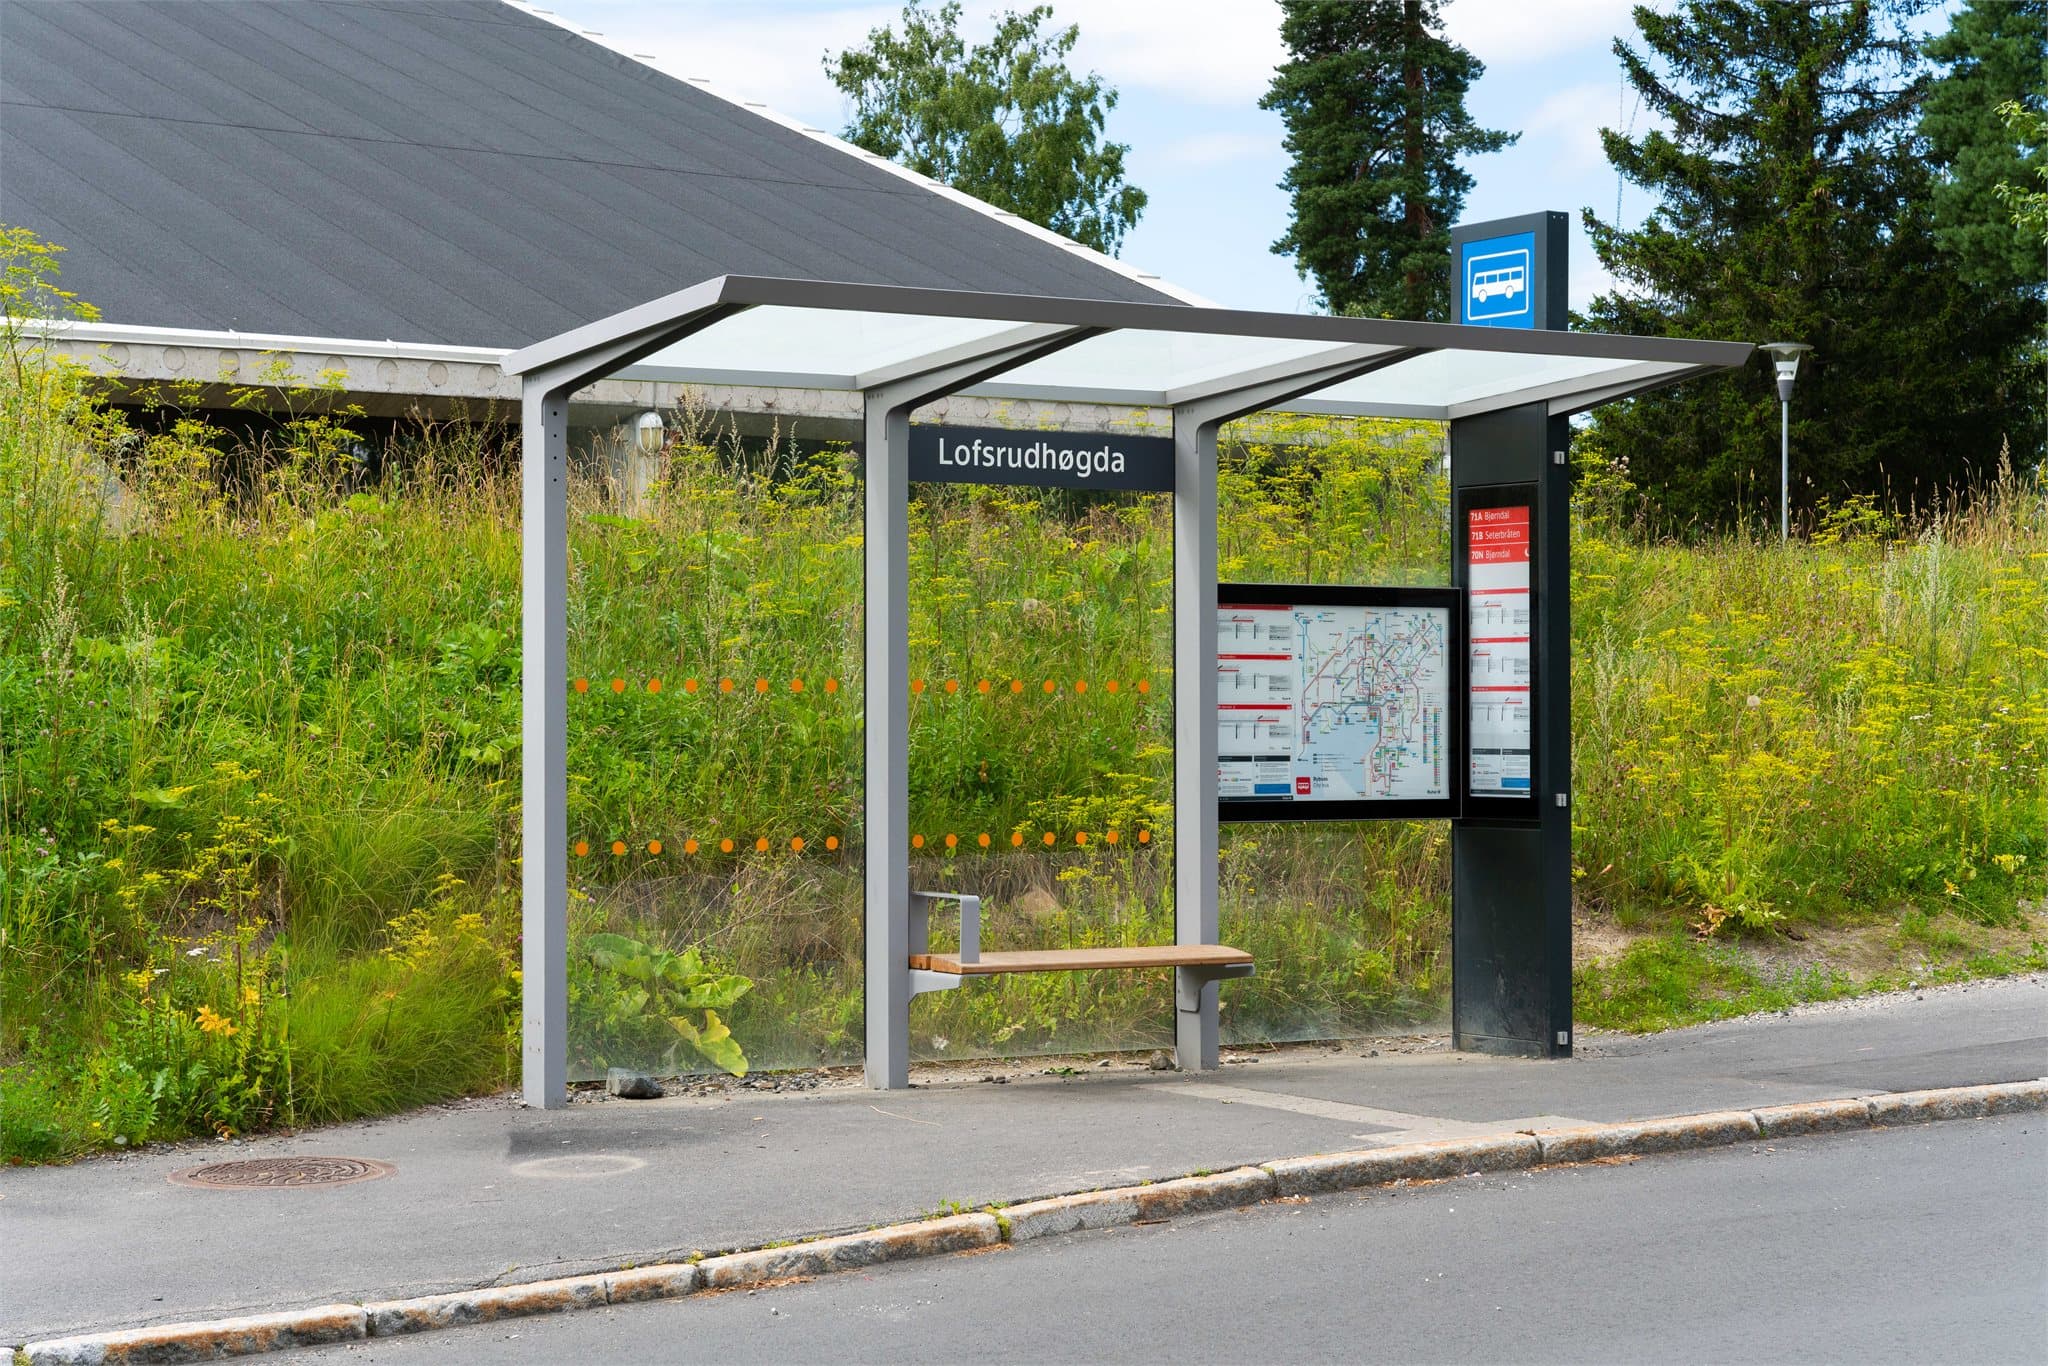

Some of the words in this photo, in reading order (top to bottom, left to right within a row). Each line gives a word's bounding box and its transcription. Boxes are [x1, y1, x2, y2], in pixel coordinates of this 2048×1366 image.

[938, 437, 1126, 479] Lofsrudhøgda
[1470, 512, 1483, 521] 71A
[1471, 531, 1484, 540] 71B
[1471, 550, 1484, 560] 70N
